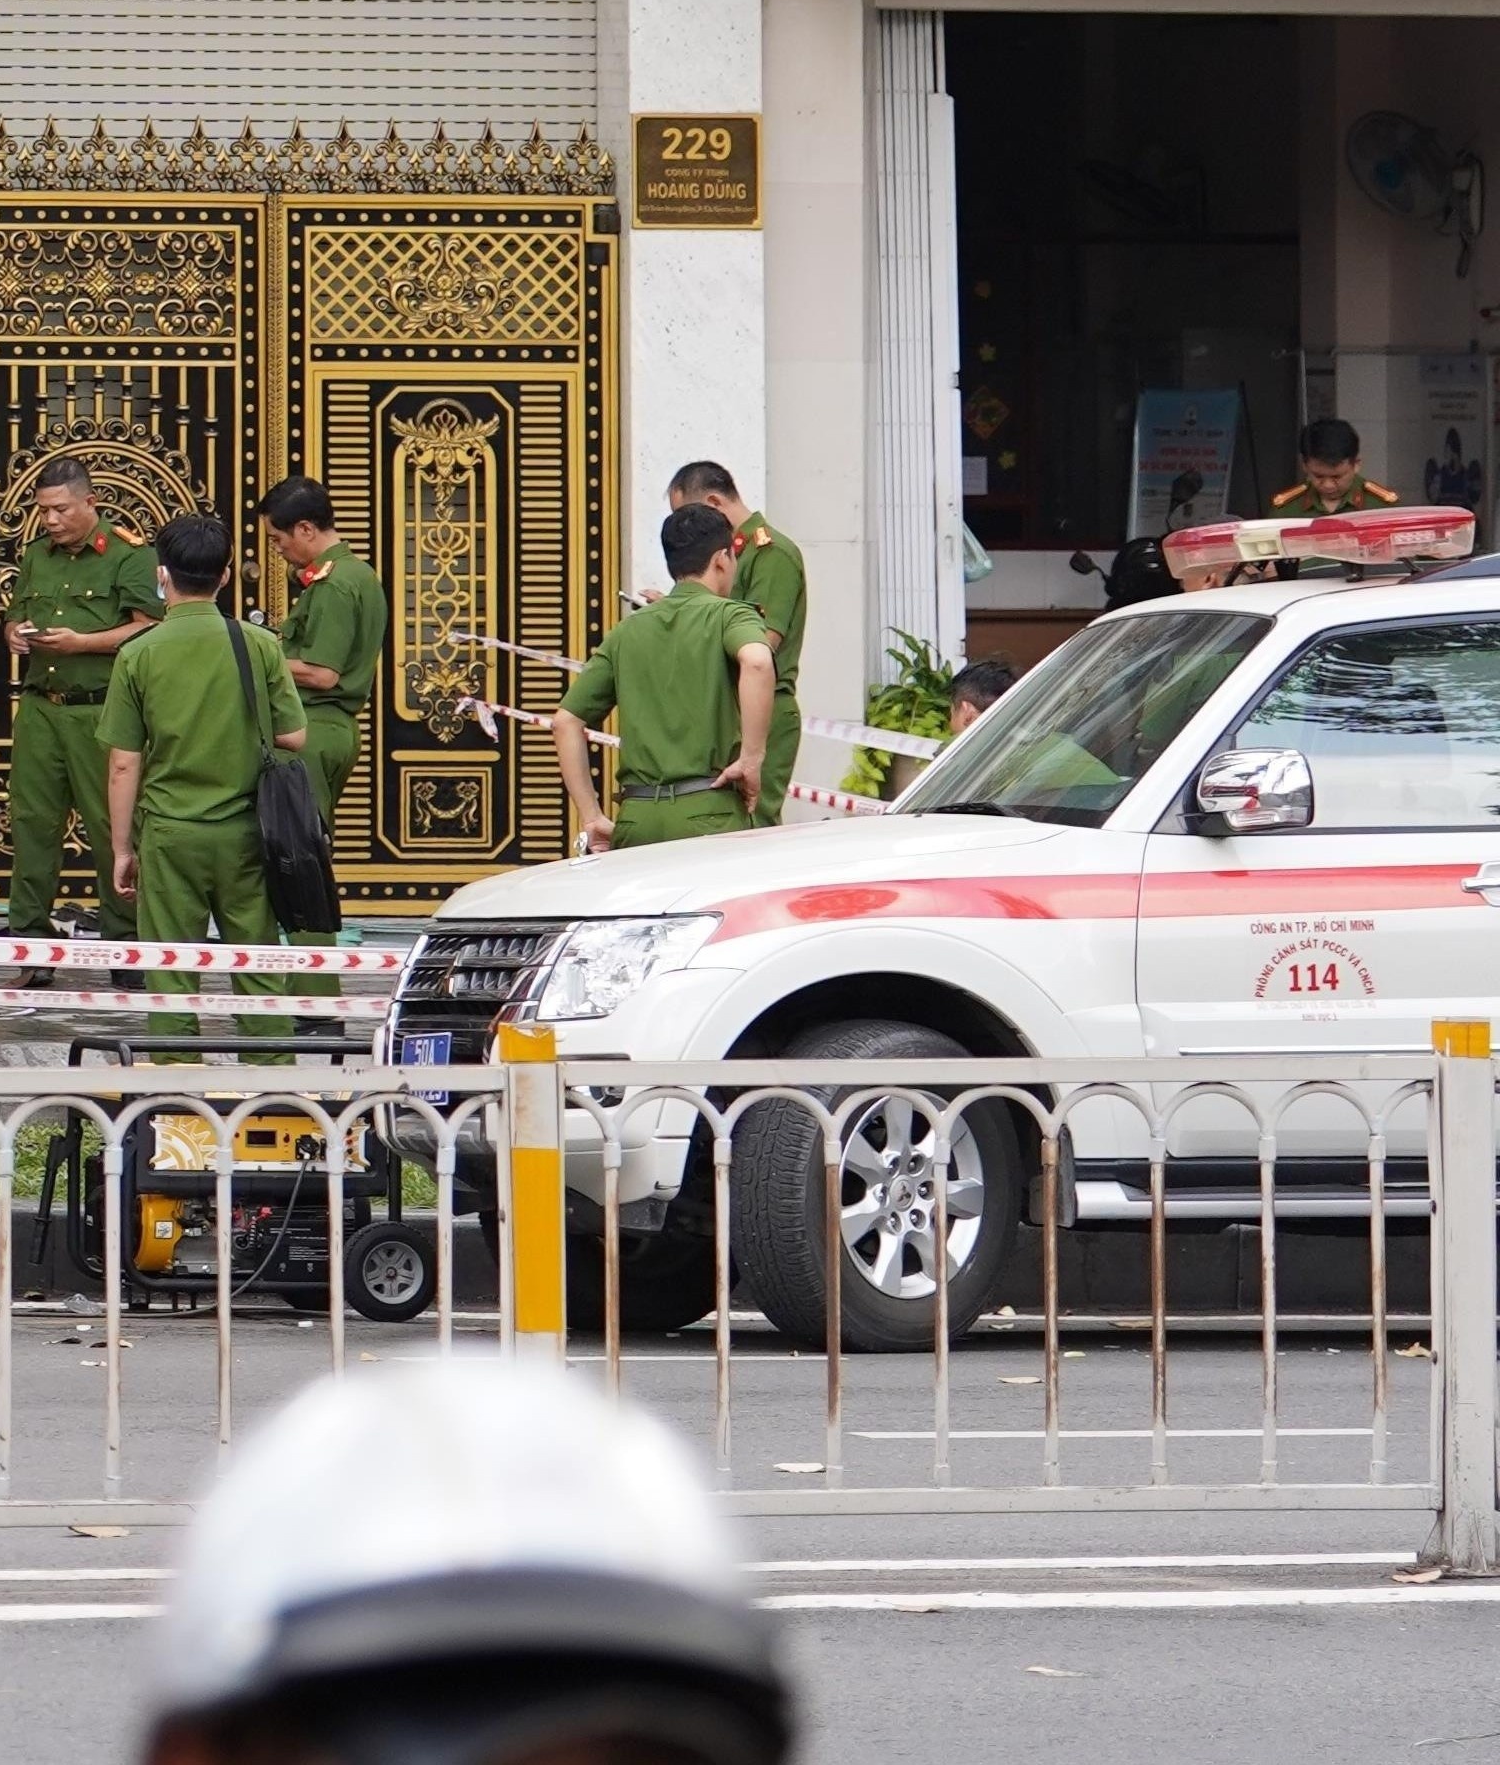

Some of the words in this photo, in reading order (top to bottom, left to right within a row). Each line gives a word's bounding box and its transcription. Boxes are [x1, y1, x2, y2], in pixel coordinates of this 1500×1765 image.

[661, 127, 732, 161] 229
[648, 178, 700, 199] HOÀNG
[1280, 922, 1292, 933] AN
[1350, 919, 1375, 931] MINH
[1254, 964, 1275, 998] PHÒNG
[1300, 937, 1318, 950] SÁT
[1322, 940, 1348, 957] PCCC
[1358, 967, 1376, 995] CNCH
[1289, 963, 1339, 992] 114
